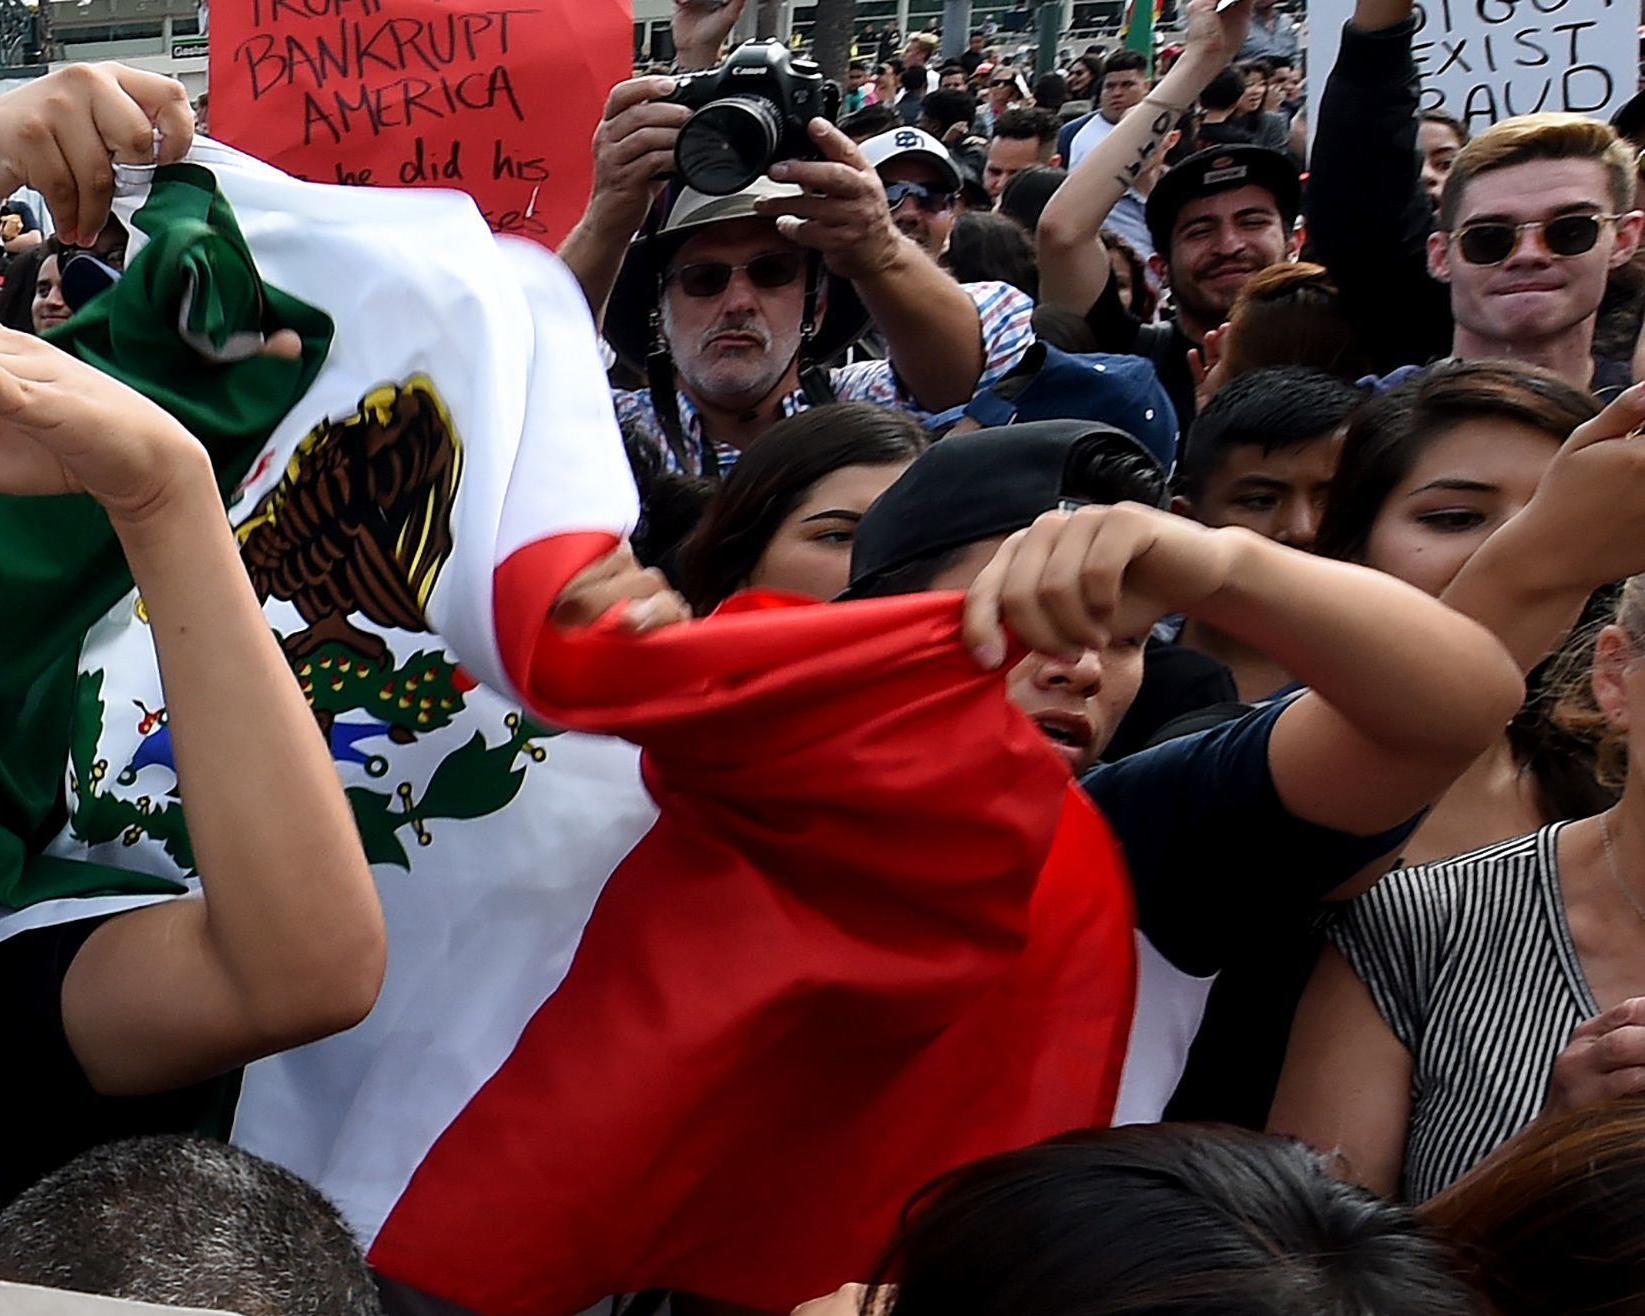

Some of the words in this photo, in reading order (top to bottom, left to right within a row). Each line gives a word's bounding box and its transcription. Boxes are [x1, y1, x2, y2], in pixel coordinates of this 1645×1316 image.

[235, 9, 543, 100] BANKRUPT
[304, 66, 524, 145] AMERICA
[399, 137, 464, 184] did
[493, 139, 549, 183] his
